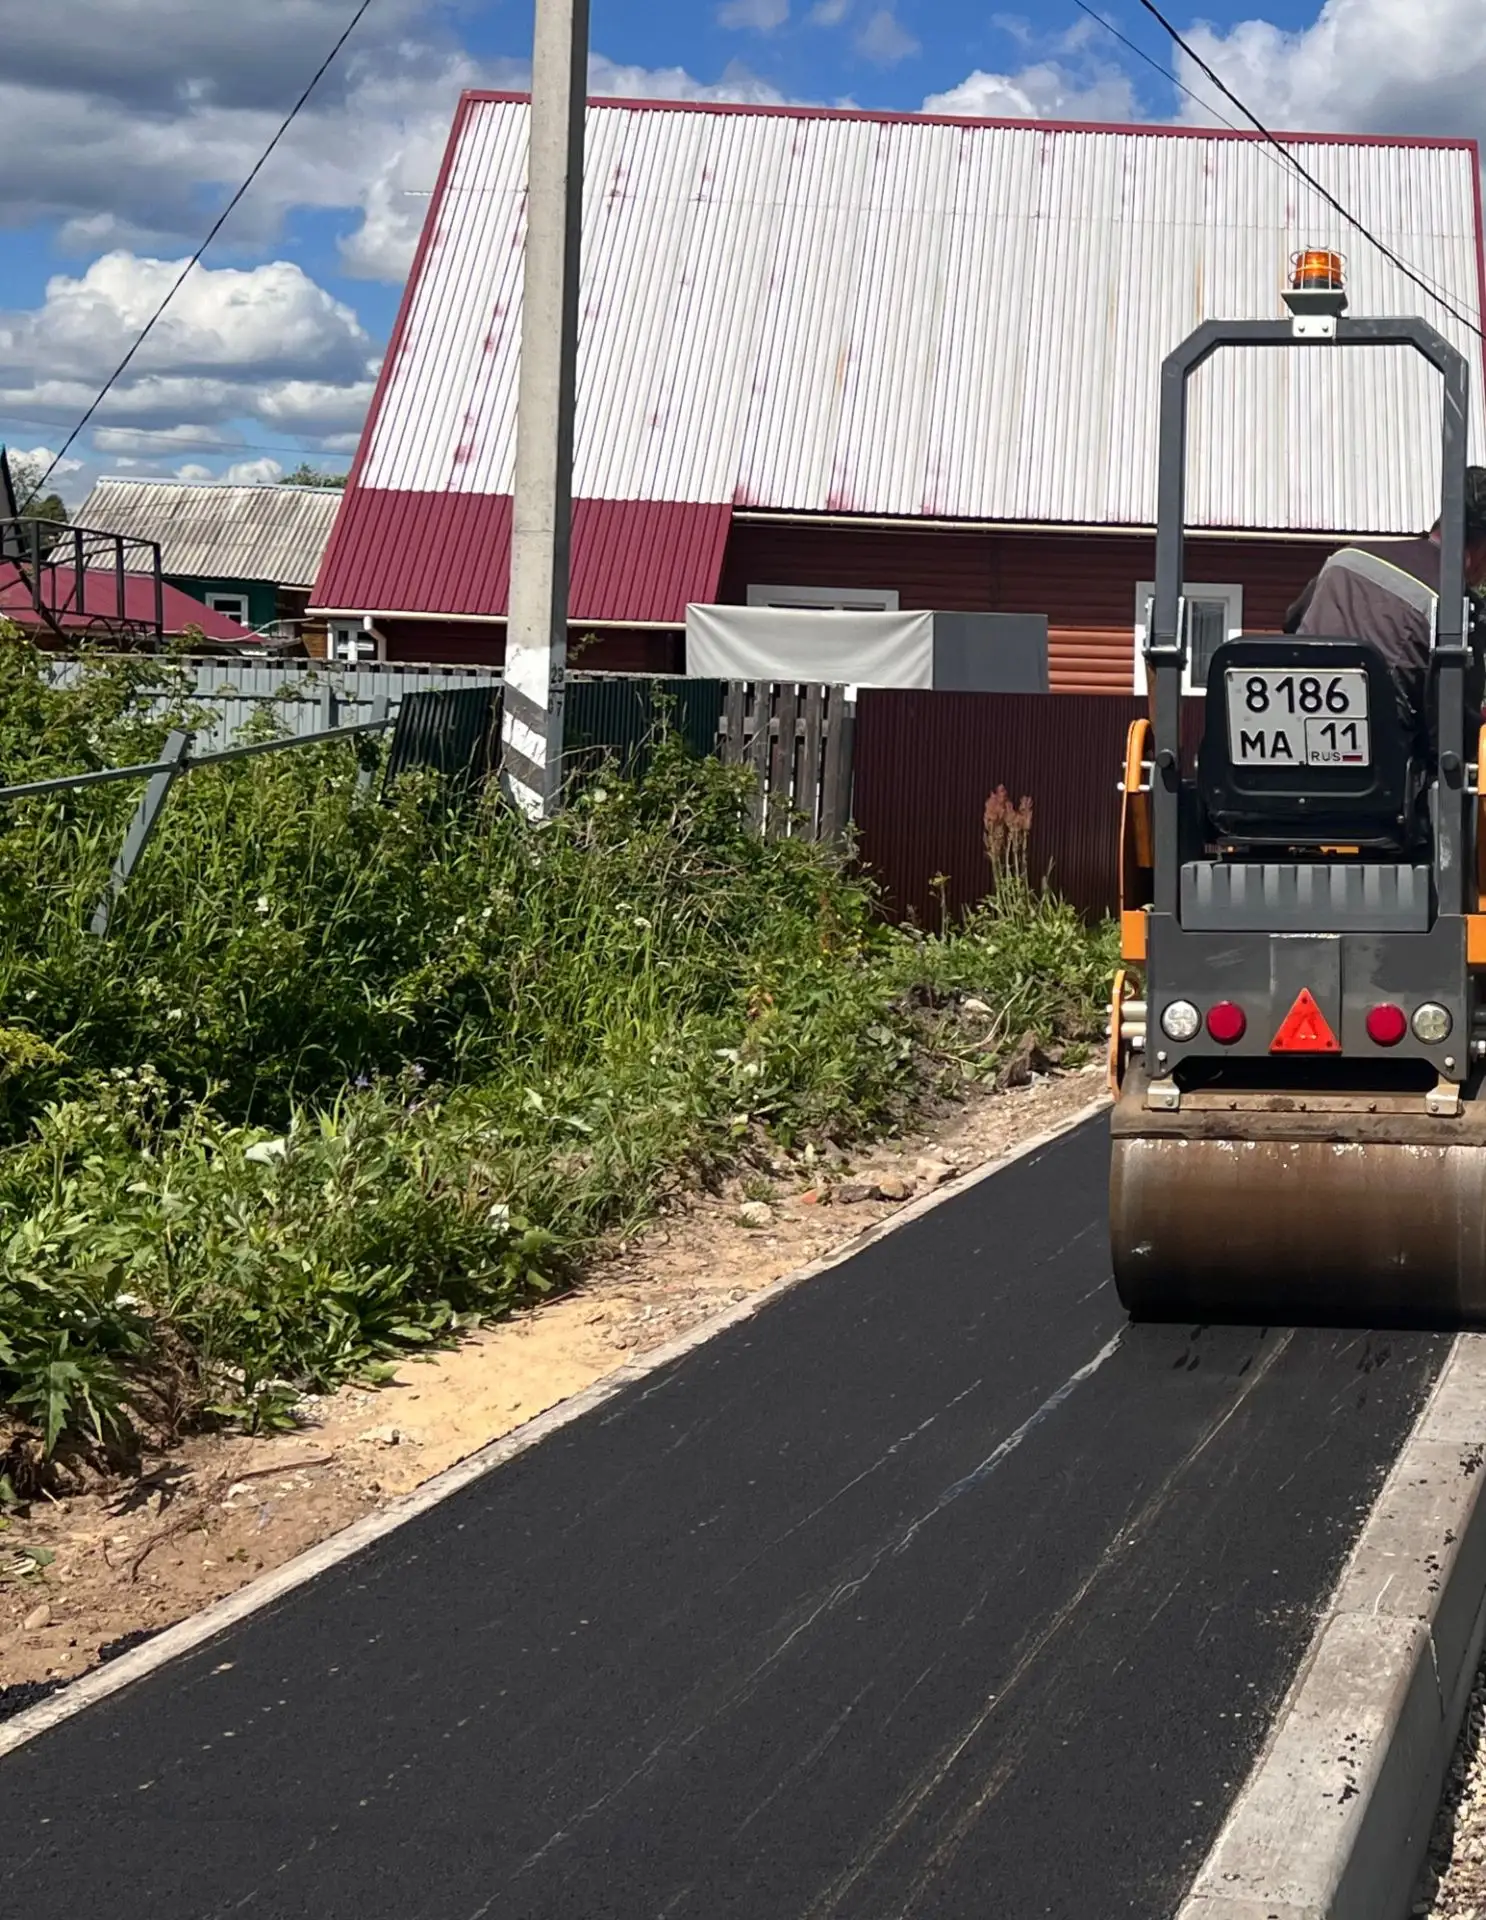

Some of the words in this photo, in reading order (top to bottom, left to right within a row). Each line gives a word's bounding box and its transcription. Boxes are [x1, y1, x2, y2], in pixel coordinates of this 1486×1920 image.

[1246, 676, 1350, 714] 8186
[1320, 722, 1358, 750] 11
[1311, 751, 1341, 762] RUS
